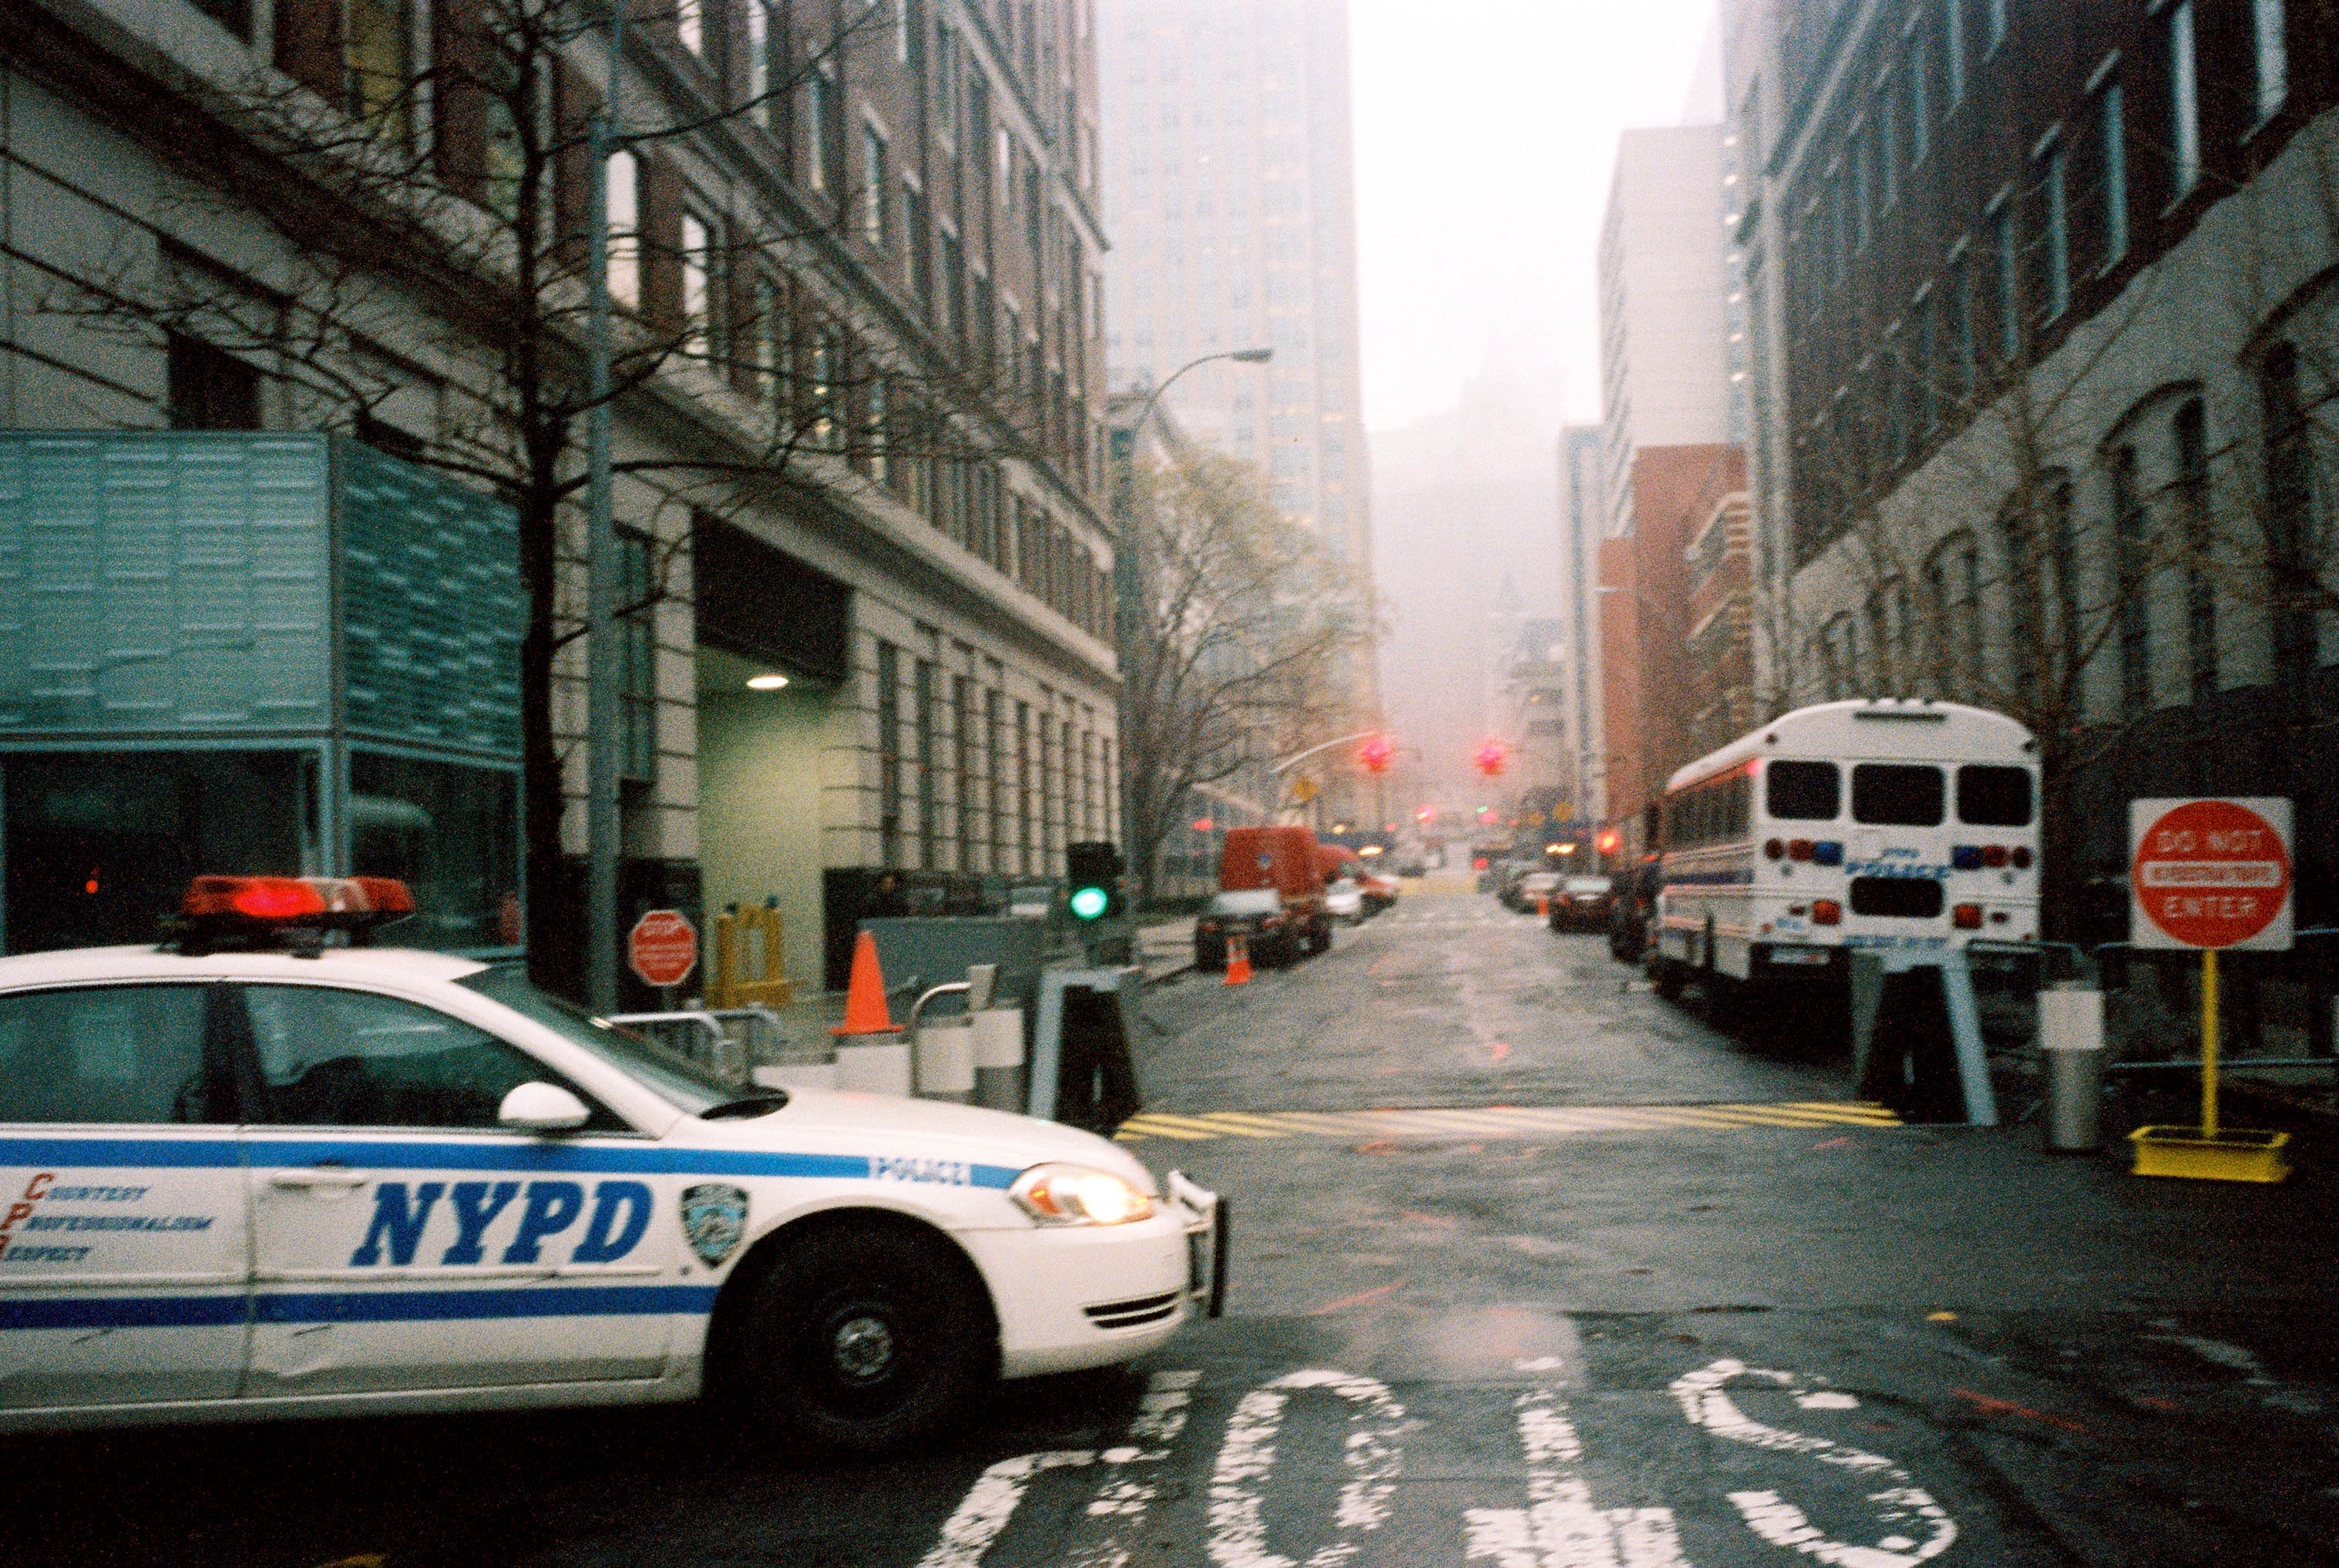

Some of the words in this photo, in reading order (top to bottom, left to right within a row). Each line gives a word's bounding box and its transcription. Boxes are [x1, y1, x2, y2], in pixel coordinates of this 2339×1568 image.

[2157, 830, 2196, 852] DO
[2206, 829, 2263, 852] NOT
[2164, 896, 2258, 918] ENTER
[871, 1157, 968, 1187] POLICE
[348, 1181, 654, 1266] NYPD
